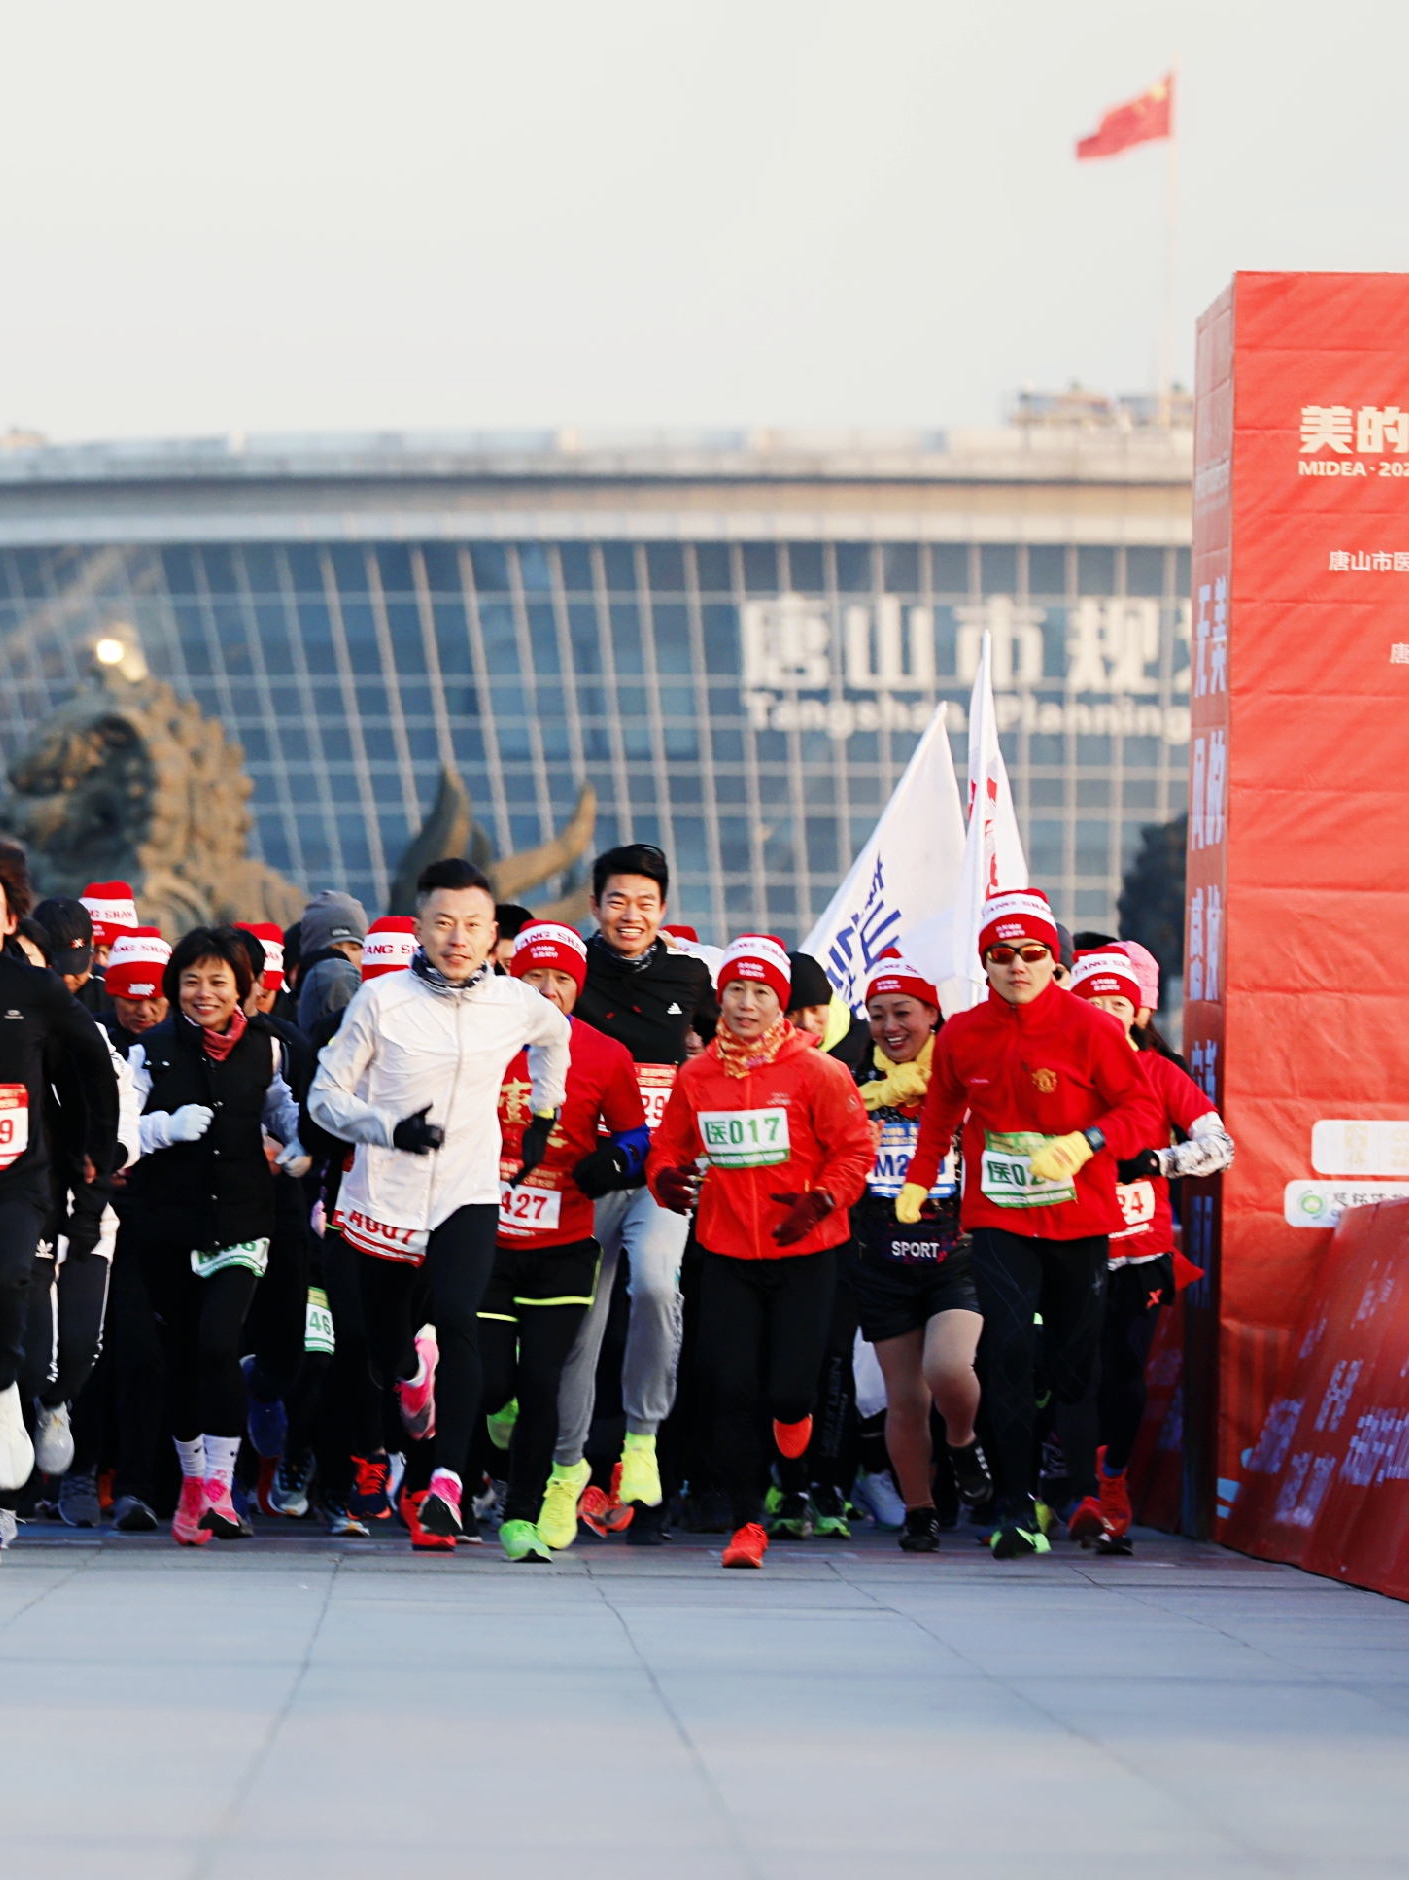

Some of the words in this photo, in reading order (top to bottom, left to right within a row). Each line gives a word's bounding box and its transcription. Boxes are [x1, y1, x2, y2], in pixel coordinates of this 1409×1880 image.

[1298, 404, 1409, 455] 美的
[1328, 549, 1409, 572] 唐山市医
[741, 593, 1191, 693] 唐山市规
[703, 1117, 780, 1145] 医017
[892, 1240, 940, 1259] SPORT
